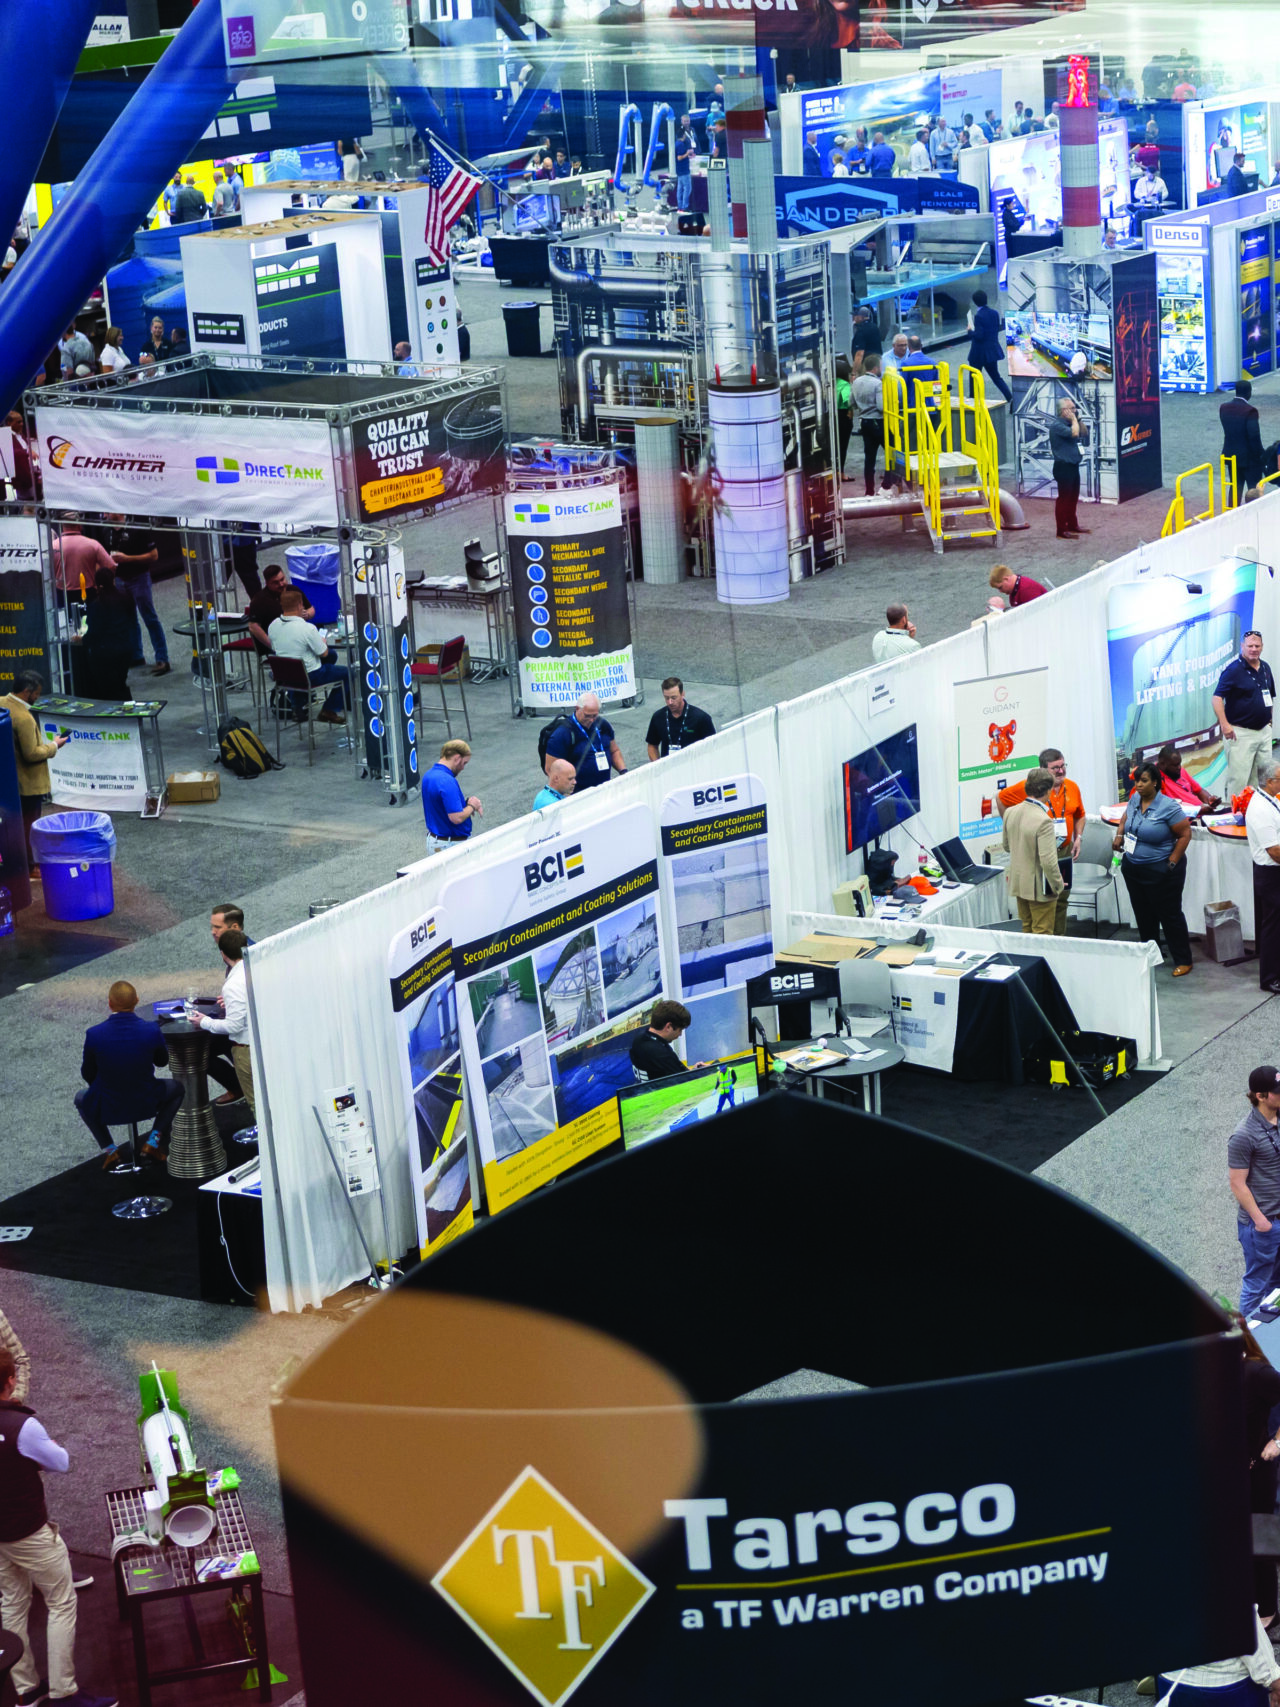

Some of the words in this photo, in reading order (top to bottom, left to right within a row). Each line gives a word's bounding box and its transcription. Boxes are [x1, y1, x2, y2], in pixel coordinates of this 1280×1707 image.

[933, 190, 964, 198] SEALS
[920, 201, 978, 209] REINVENTED
[1155, 227, 1200, 242] Denso
[259, 317, 288, 333] ODUCTS
[367, 410, 429, 441] QUALITY
[1121, 423, 1140, 446] GX
[368, 438, 397, 460] YOU
[400, 429, 430, 452] CAN
[72, 456, 166, 473] CHARTER
[377, 450, 424, 477] TRUST
[73, 471, 126, 480] INDUSTRIAL
[130, 474, 164, 482] SUPPLY
[0, 548, 38, 557] RTER
[550, 542, 580, 552] PRIMARY
[551, 549, 591, 561] MECHANICAL
[552, 563, 588, 574] SECONDARY
[552, 572, 582, 583] METALLIC
[583, 569, 600, 580] WIPER
[554, 585, 589, 596] SECONDARY
[591, 581, 608, 592] WEDGE
[0, 602, 24, 610] YSTEMS
[554, 595, 575, 604] WIPER
[556, 607, 591, 618] SECONDARY
[556, 616, 570, 626] LOW
[571, 614, 595, 626] PROFILE
[558, 630, 586, 639] INTEGRAL
[559, 639, 576, 648] FOAM
[577, 637, 594, 647] DAMS
[18, 647, 44, 656] COVERS
[525, 661, 565, 673] PRIMARY
[567, 661, 584, 671] AND
[586, 653, 631, 670] SECONDARY
[1150, 661, 1182, 681] TANK
[1185, 639, 1234, 675] FOUNDATIONS
[535, 671, 570, 683] SEALING
[572, 667, 607, 682] SYSTEMS
[608, 664, 624, 676] FOR
[531, 681, 571, 693] EXTERNAL
[575, 681, 592, 692] AND
[593, 673, 629, 689] INTERNAL
[550, 691, 581, 702] FLOATI
[1136, 680, 1183, 706] LIFTING
[1187, 678, 1196, 693] &
[982, 701, 1020, 716] GUIDANT
[961, 769, 978, 778] Smith
[670, 823, 713, 839] Secondary
[713, 809, 765, 829] Containment
[675, 837, 691, 847] and
[692, 830, 724, 844] Coating
[725, 821, 762, 836] Solutions
[463, 939, 508, 966] Secondary
[509, 915, 565, 947] Containment
[566, 903, 583, 918] and
[583, 889, 616, 914] Coating
[617, 871, 654, 898] Solutions
[400, 965, 425, 989] Secondary
[403, 984, 414, 999] and
[413, 972, 431, 993] Coating
[430, 957, 452, 980] Solutions
[664, 1482, 1017, 1571] Tarsco
[681, 1606, 705, 1629] a
[713, 1600, 764, 1629] TF
[772, 1582, 925, 1629] Warren
[934, 1552, 1109, 1602] Company
